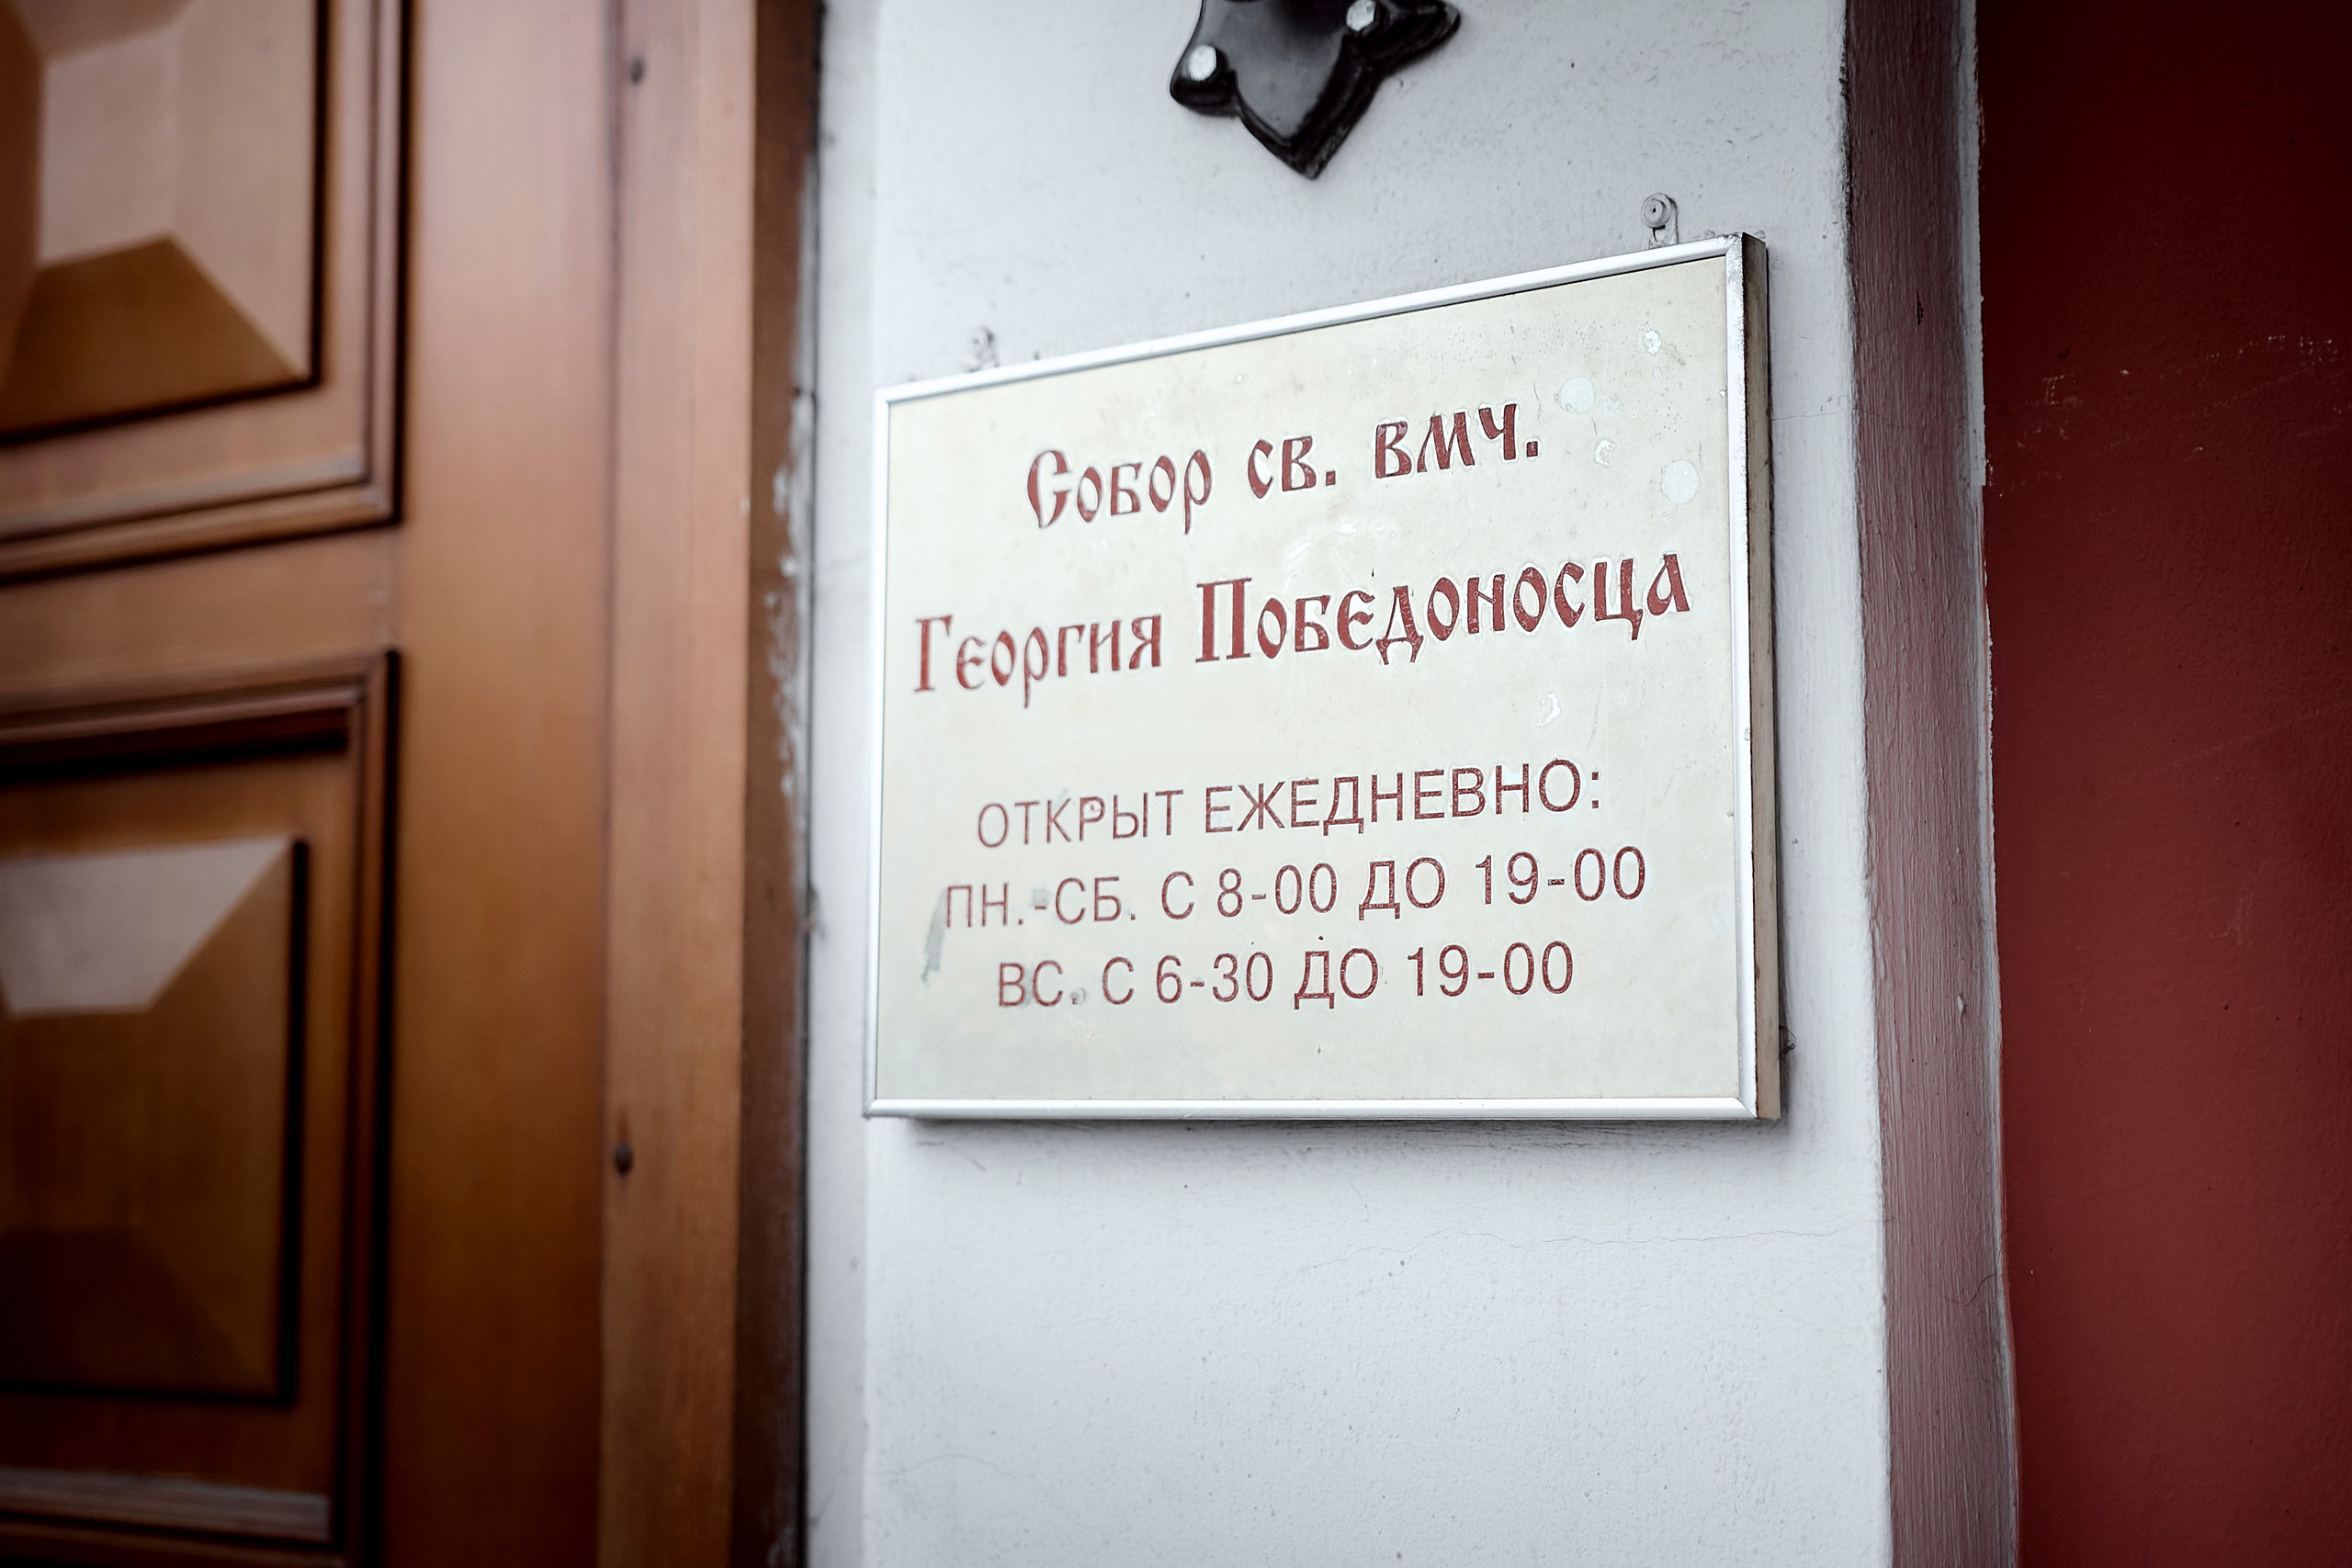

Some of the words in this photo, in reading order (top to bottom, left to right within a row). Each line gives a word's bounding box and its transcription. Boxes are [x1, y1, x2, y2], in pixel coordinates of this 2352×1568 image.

[1024, 447, 1213, 535] Собор
[1246, 435, 1338, 500] св.
[1374, 402, 1540, 479] вмч.
[913, 612, 1163, 708] Георгия
[1194, 553, 1690, 667] Победоносца
[977, 788, 1185, 850] ОТКРЫТ
[1204, 758, 1601, 837] ЕЖЕДНЕВНО:
[944, 874, 1138, 929] ПН.-СБ.
[1160, 871, 1194, 921] С
[1216, 862, 1338, 919] 8-00
[1357, 856, 1447, 922] ДО
[1474, 845, 1647, 906] 19-00
[997, 959, 1081, 1009] ВС.
[1101, 955, 1135, 1007] С
[1155, 951, 1273, 1005] 6-30
[1293, 947, 1380, 1011] ДО
[1407, 940, 1575, 998] 19-00
